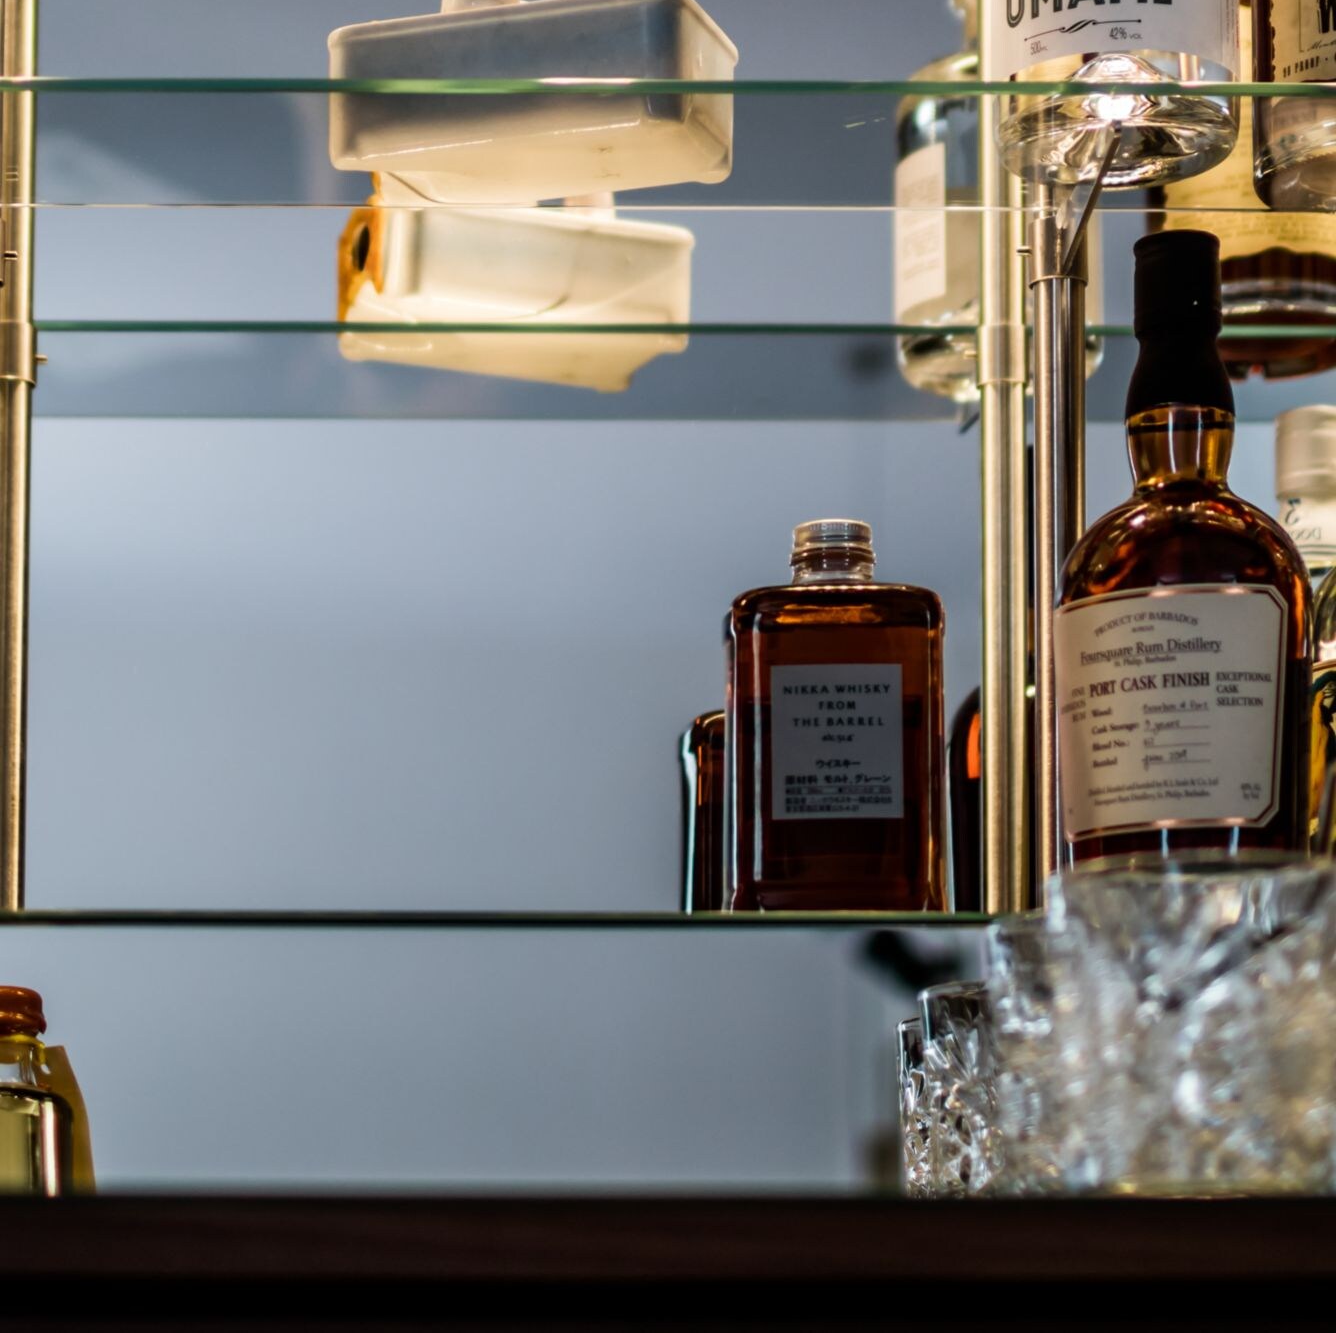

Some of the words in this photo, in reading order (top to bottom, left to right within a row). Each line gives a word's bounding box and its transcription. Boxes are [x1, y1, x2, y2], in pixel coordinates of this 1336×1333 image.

[1093, 614, 1131, 636] PRODUCT
[1133, 612, 1146, 622] OF
[1148, 611, 1199, 627] BARBADOS
[1080, 646, 1133, 665] Foursquare
[1135, 641, 1164, 654] Rum
[1166, 636, 1222, 653] Distillery
[1216, 672, 1272, 682] EXCEPTIONAL
[783, 685, 830, 695] NIKKA
[835, 684, 890, 694] WHISKY
[1089, 679, 1117, 698] PORT
[1119, 674, 1158, 692] CASK
[1162, 671, 1210, 688] FINISH
[1216, 684, 1239, 694] CASK
[818, 700, 856, 711] FROM
[1216, 696, 1264, 707] SELECTION
[793, 717, 820, 727] THE
[827, 716, 885, 727] BARREL
[815, 758, 861, 769] ウイスキー
